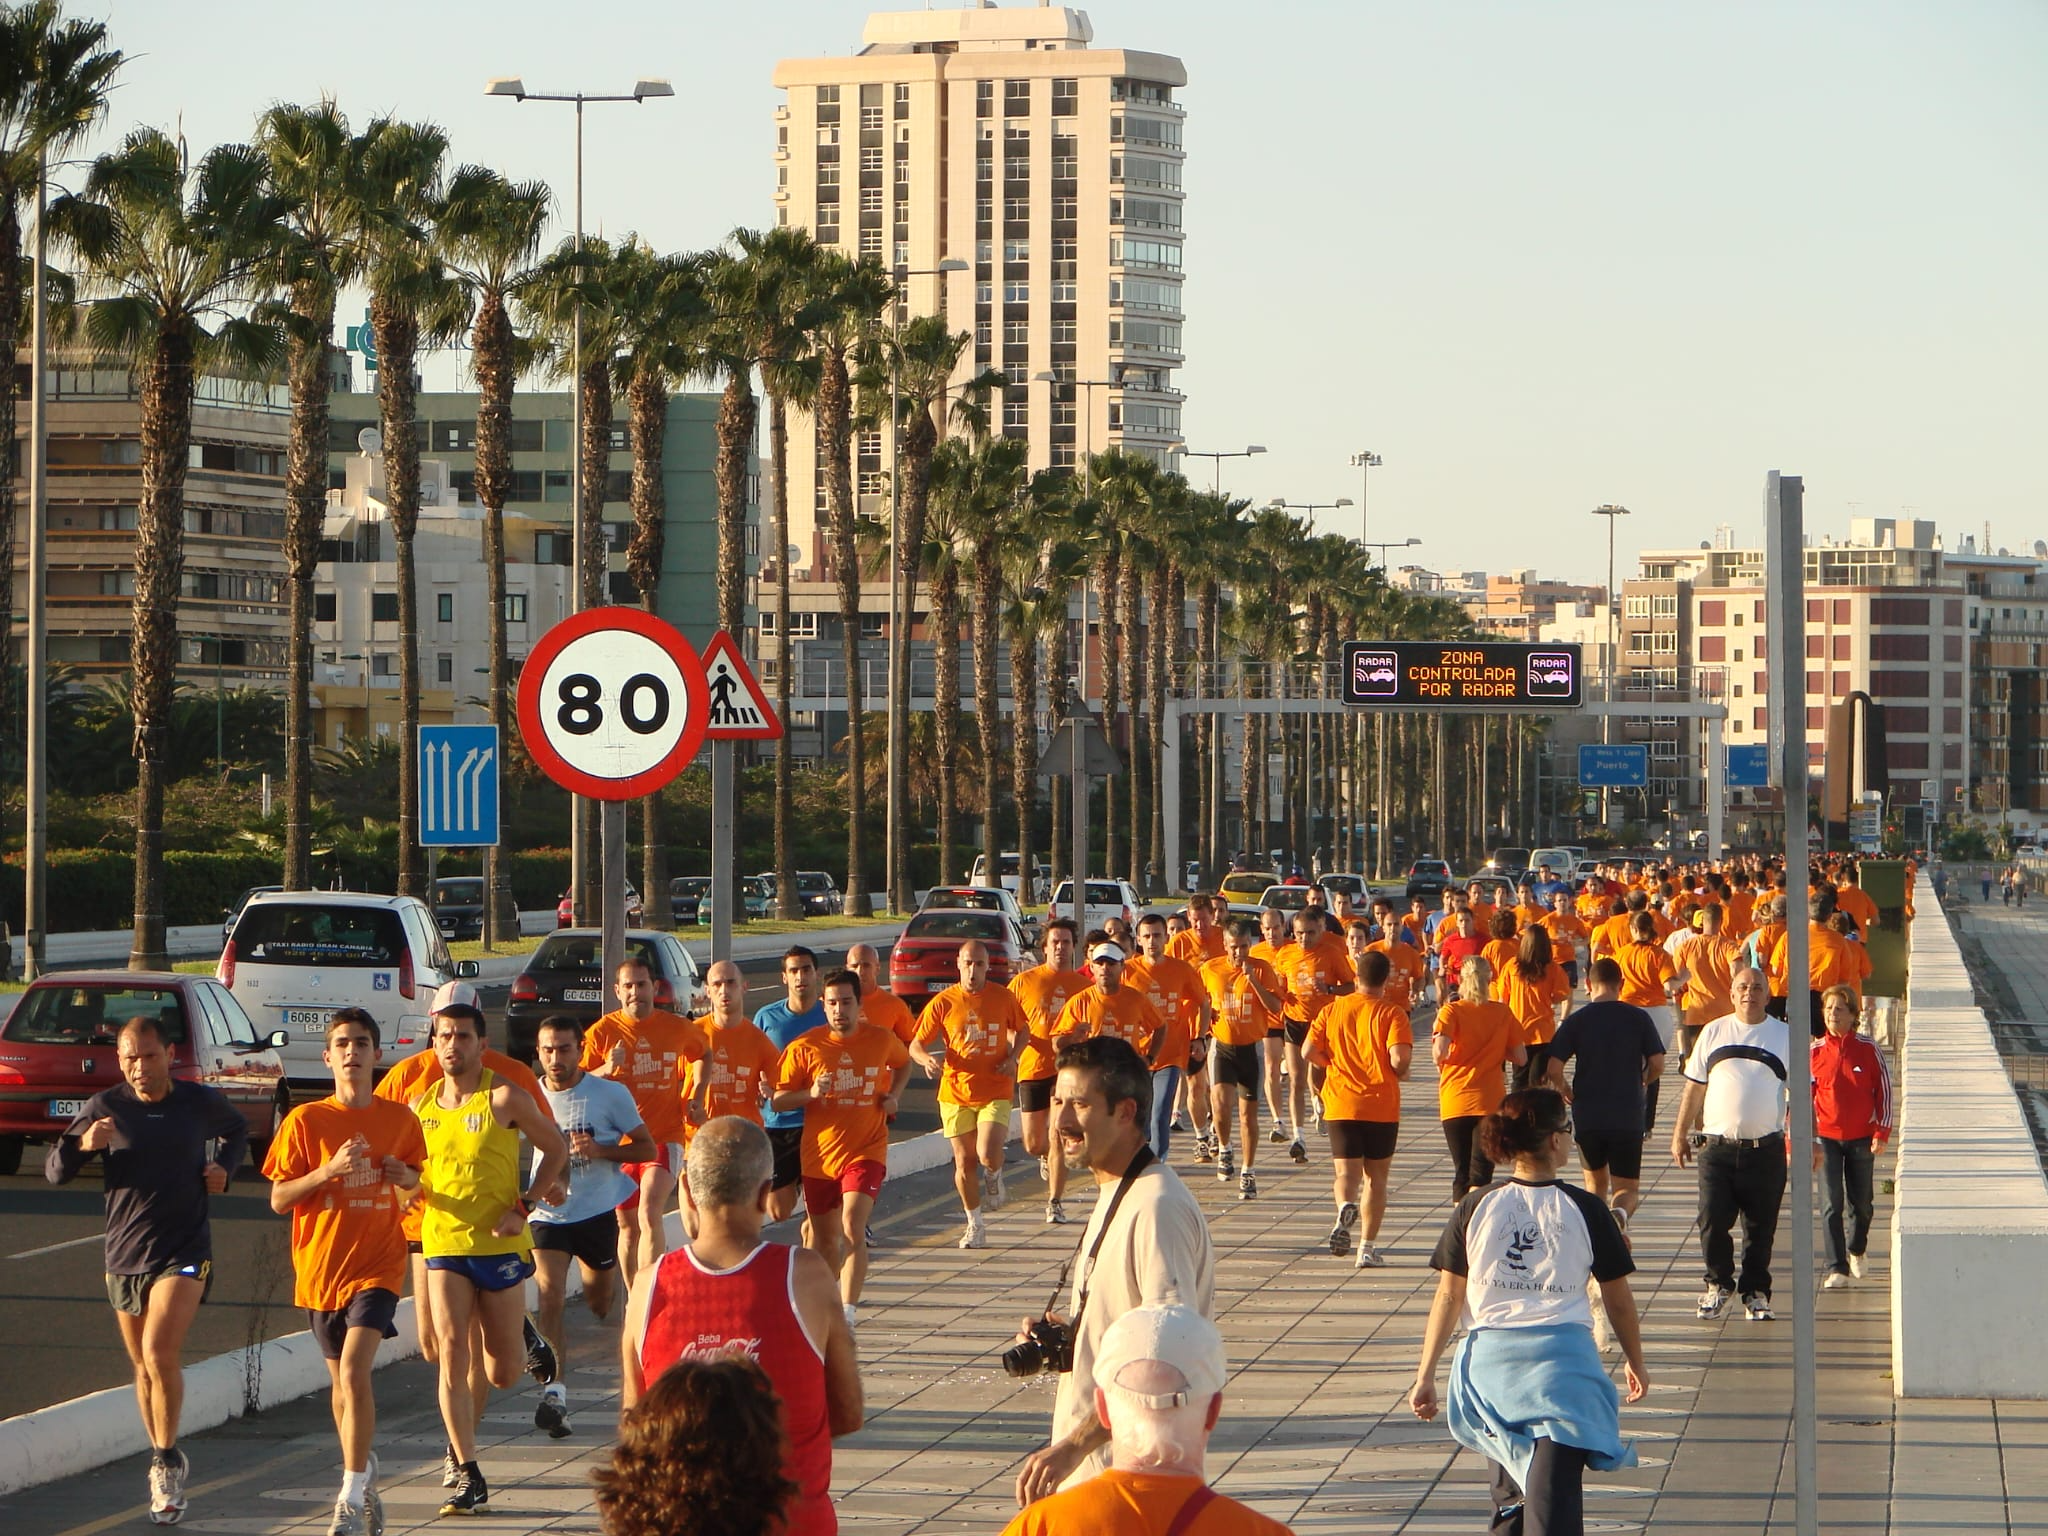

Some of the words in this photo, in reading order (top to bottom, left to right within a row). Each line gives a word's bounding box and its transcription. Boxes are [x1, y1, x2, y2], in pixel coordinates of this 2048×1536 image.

[1358, 657, 1393, 666] RADAR
[1441, 651, 1483, 665] ZONA
[1532, 659, 1567, 668] RADAR
[1409, 667, 1516, 681] CONTROLADA
[1419, 683, 1451, 697] POR
[1462, 684, 1516, 697] RADAR
[557, 673, 670, 735] 80
[1596, 760, 1629, 769] Puerto
[290, 1011, 319, 1023] 6069
[57, 1101, 73, 1114] GC
[1493, 1279, 1506, 1289] YA
[1509, 1281, 1531, 1290] ERA
[698, 1334, 721, 1345] Beba
